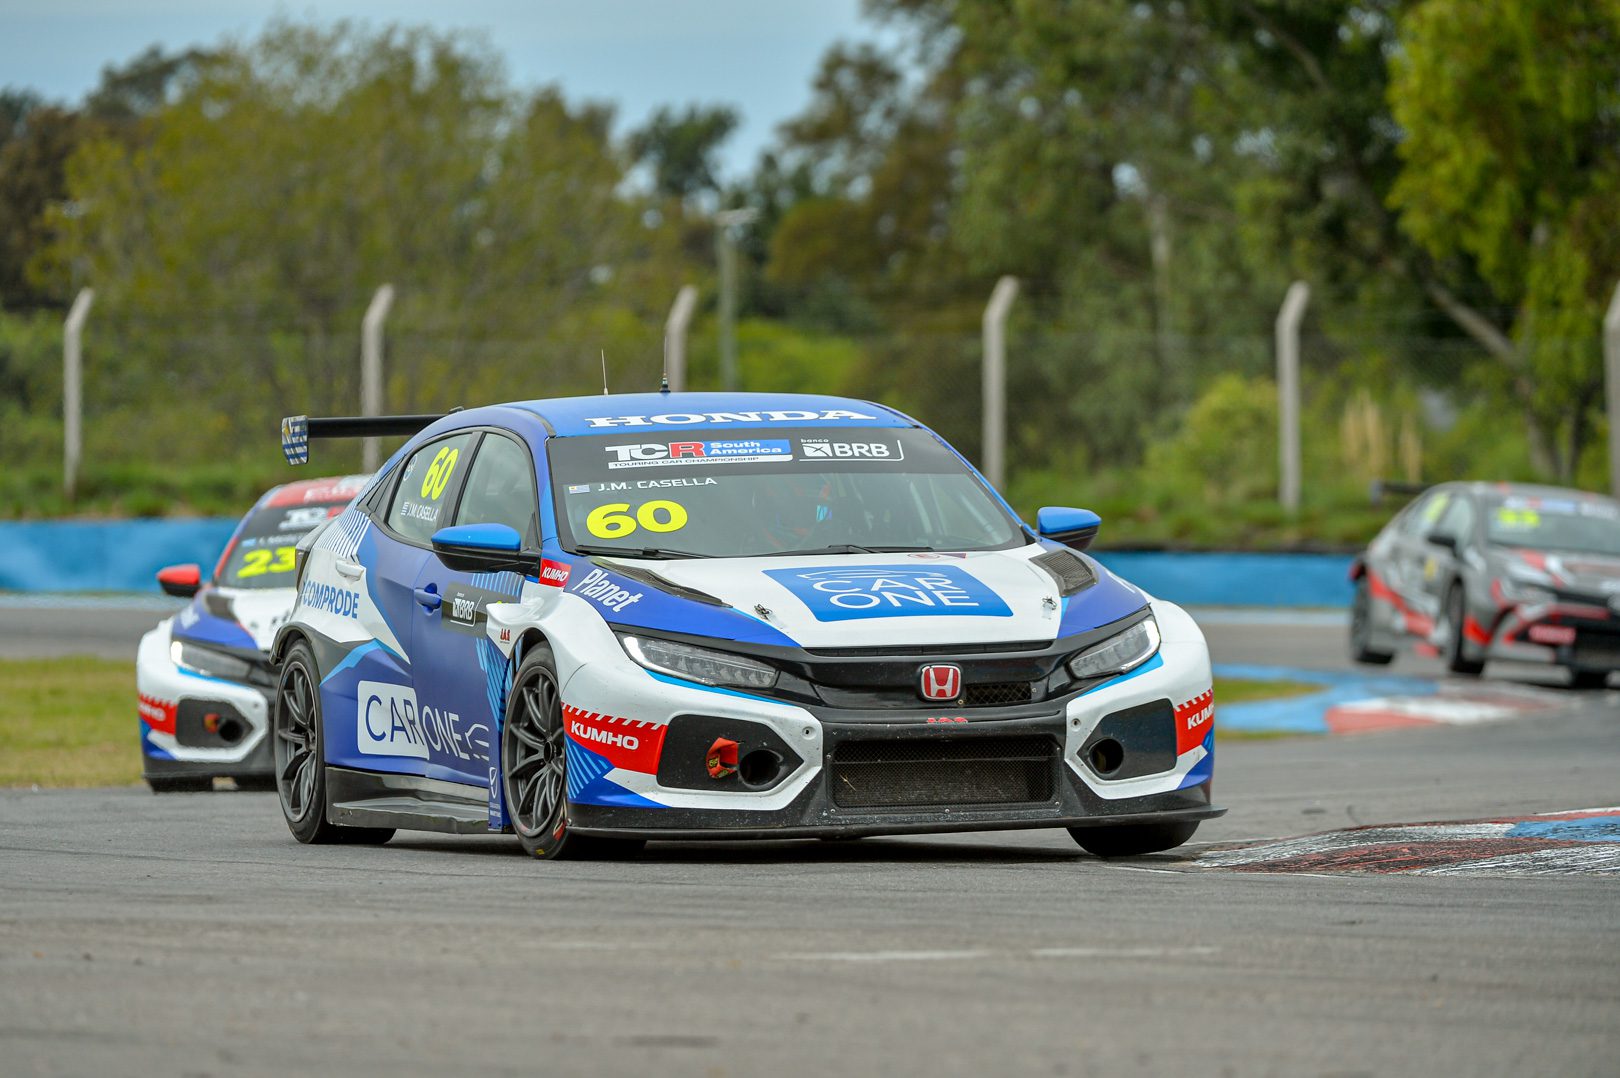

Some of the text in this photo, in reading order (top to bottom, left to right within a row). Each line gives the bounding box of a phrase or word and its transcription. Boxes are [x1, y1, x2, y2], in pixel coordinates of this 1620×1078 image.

[585, 410, 877, 428] HONDA
[605, 441, 706, 462] TCR
[710, 447, 783, 455] America
[832, 443, 890, 457] BRB
[612, 460, 659, 468] TOURING
[685, 456, 760, 464] CHAMPIONSHIP
[421, 446, 459, 501] 60
[598, 477, 718, 492] J.M. CASELLA
[416, 504, 439, 522] CASELLA
[586, 499, 688, 539] 60
[237, 546, 296, 578] 23
[541, 566, 569, 582] KUMHO
[572, 568, 644, 613] Planet
[812, 577, 963, 593] CAR
[303, 580, 360, 619] COMPRODE
[829, 590, 980, 609] ONE
[366, 695, 471, 760] CAR ONE
[571, 720, 639, 750] KUMHO
